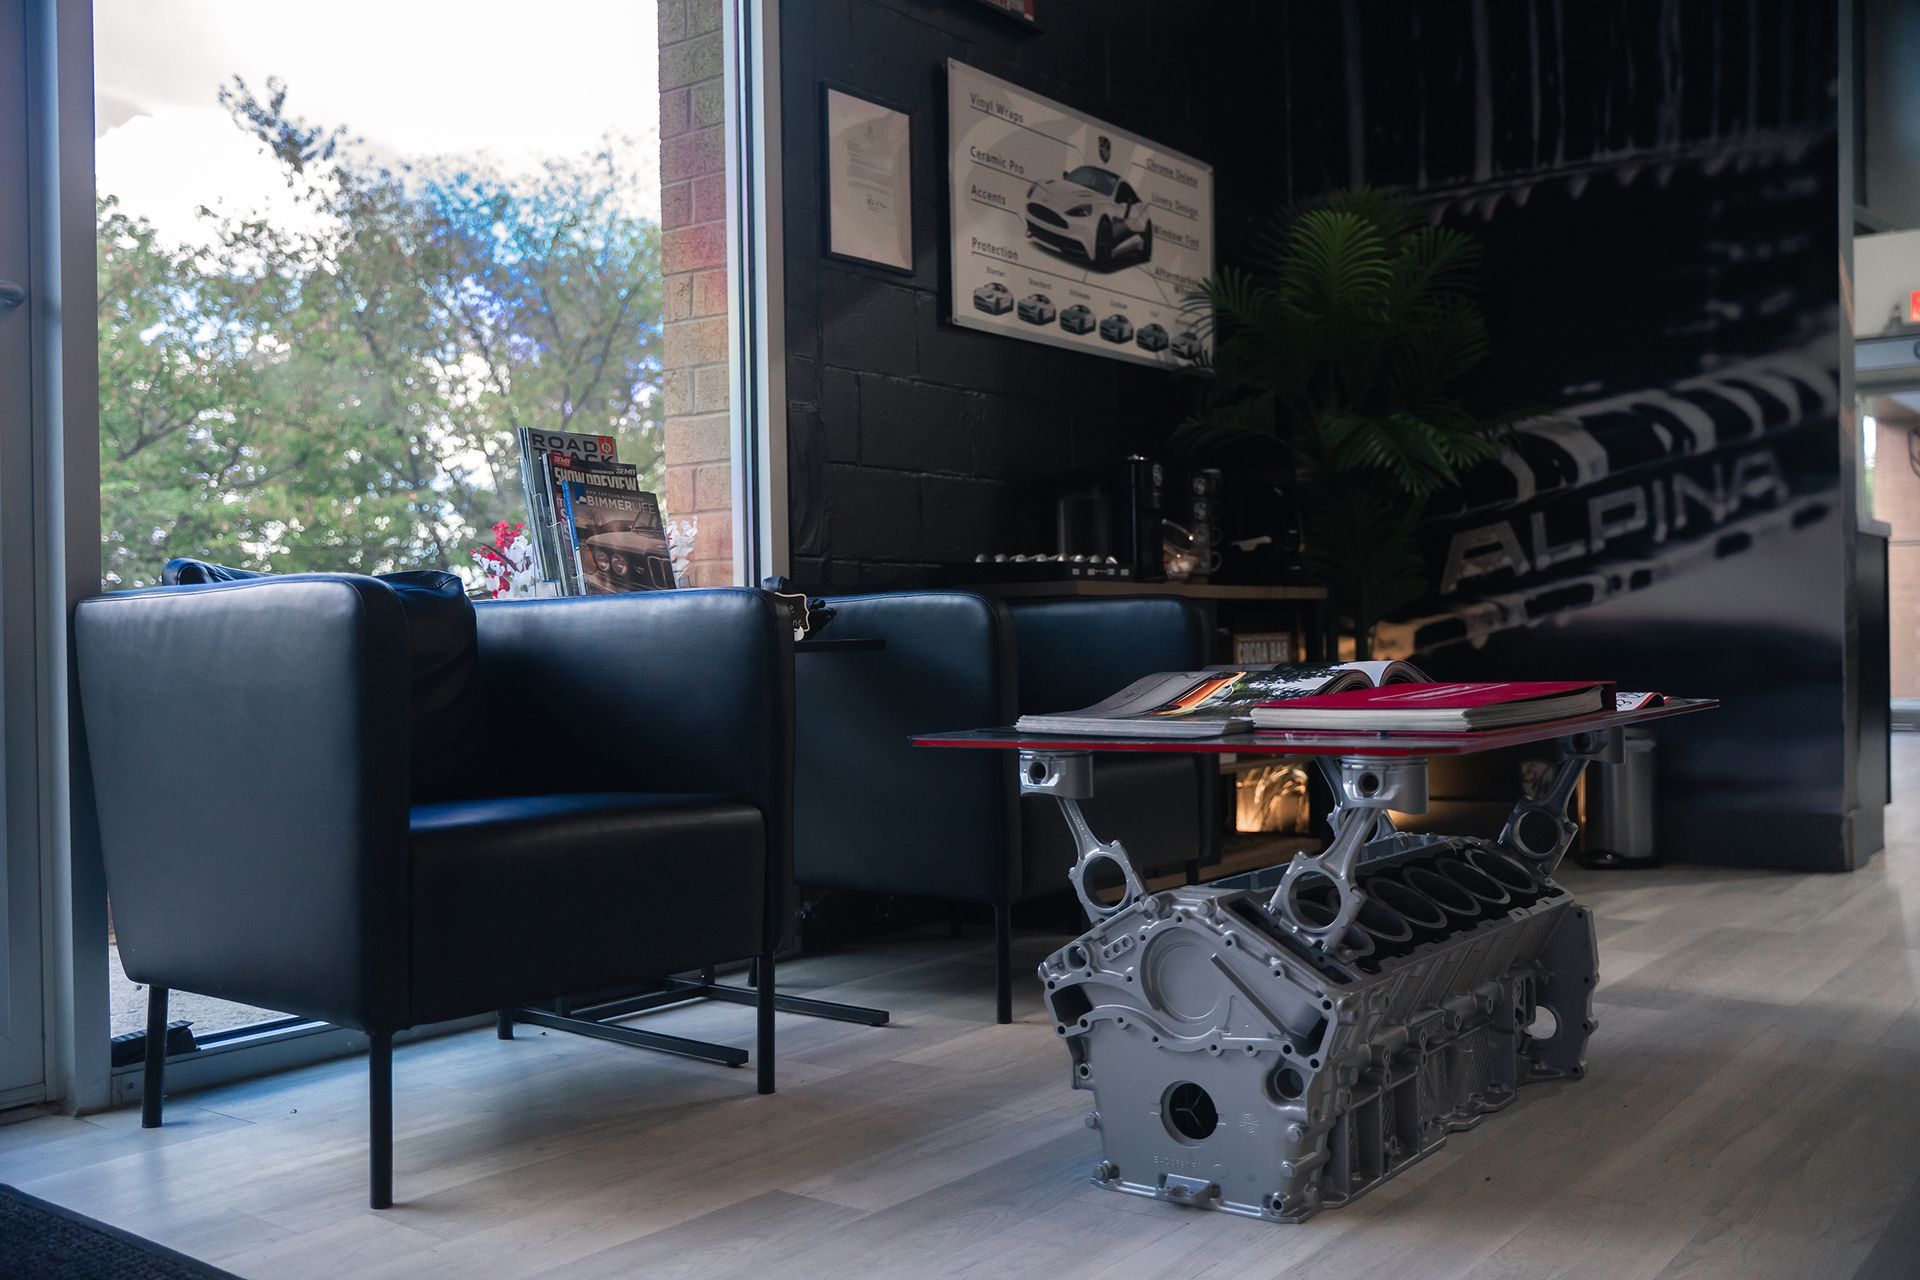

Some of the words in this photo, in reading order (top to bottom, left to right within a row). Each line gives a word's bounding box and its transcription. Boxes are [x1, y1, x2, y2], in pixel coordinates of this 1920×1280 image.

[970, 92, 993, 113] Vinyl
[996, 103, 1024, 124] Wraps
[970, 146, 1006, 169] Ceramic
[1009, 160, 1024, 175] Pro
[971, 185, 1006, 206] Accents
[972, 237, 1018, 261] Protection
[531, 433, 598, 453] ROAD
[1441, 450, 1790, 595] ALPINA
